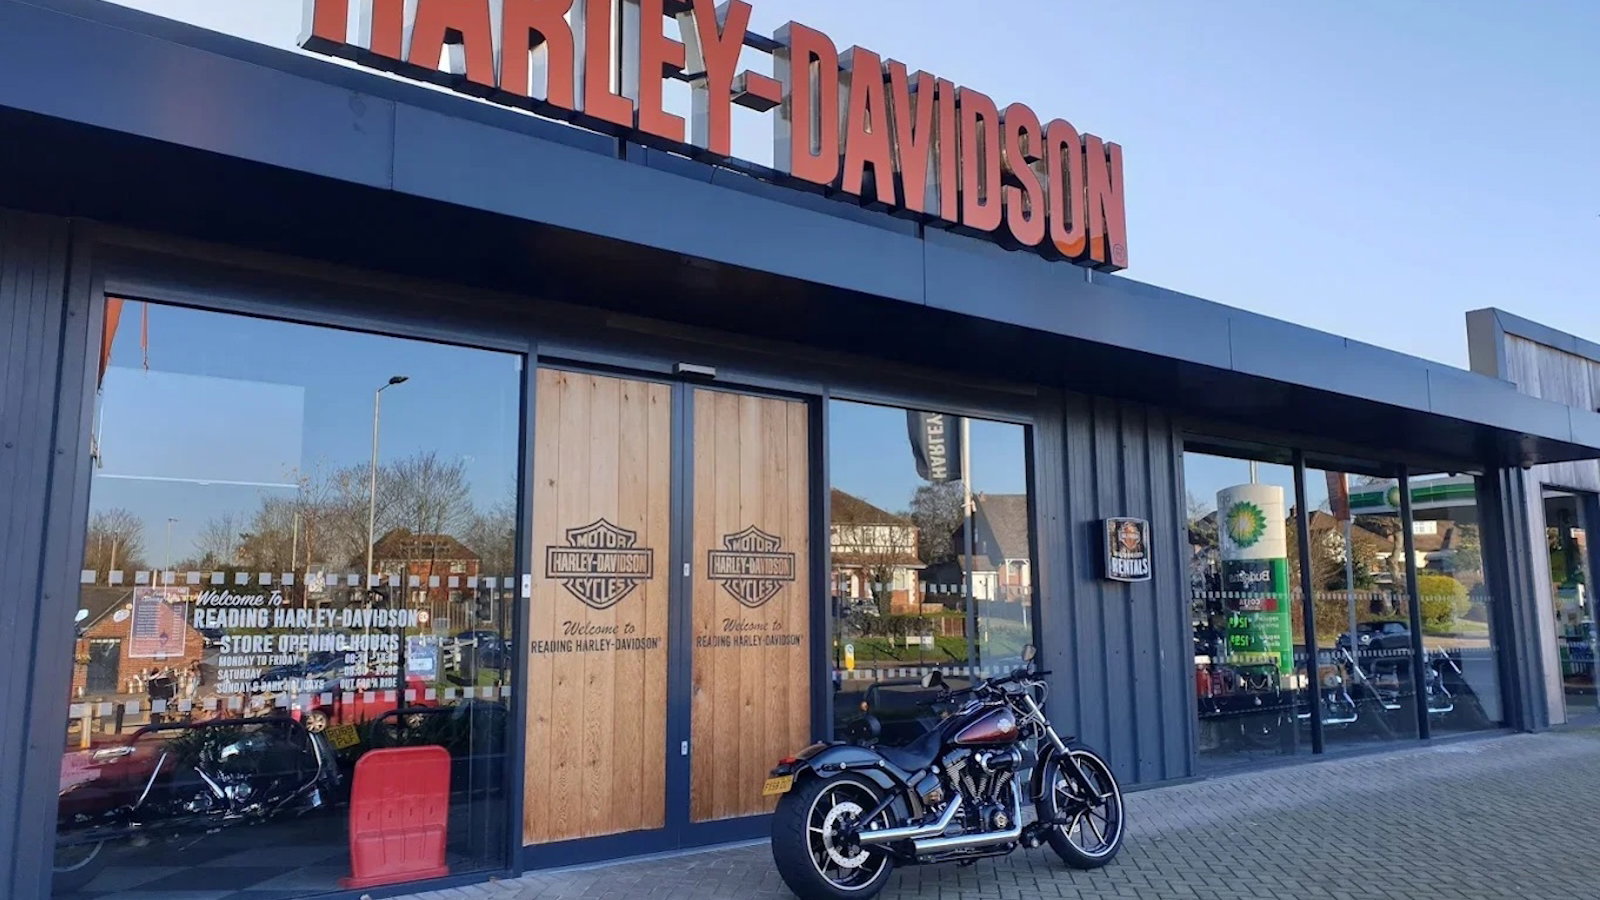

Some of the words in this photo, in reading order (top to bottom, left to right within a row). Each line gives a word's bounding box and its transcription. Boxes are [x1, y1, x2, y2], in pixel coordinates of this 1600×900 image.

[303, 0, 1128, 270] RLEY-DAVIDSON
[577, 533, 627, 548] MOTOR
[733, 538, 774, 552] MOTOR
[554, 551, 647, 574] HARLEY-DAVIDSON
[714, 556, 791, 576] HARLEY-DAVIDSON
[1111, 557, 1148, 575] RENTALS
[576, 578, 626, 599] CYCLES
[731, 579, 773, 598] CYCLES
[195, 589, 264, 606] Welcome
[268, 590, 283, 605] To
[193, 607, 269, 629] READING
[273, 607, 418, 629] HARLEY-DAVIDSON
[722, 618, 769, 632] Welcome
[772, 620, 783, 632] to
[563, 621, 618, 635] Welcome
[624, 622, 635, 634] to
[220, 634, 273, 654] STORE
[278, 633, 347, 653] OPENING
[351, 633, 399, 652] HOURS
[531, 639, 572, 653] READING
[575, 637, 658, 652] HARLEY-DAVIDSON
[696, 636, 731, 648] READING
[733, 635, 800, 648] HARLEY-DAVIDSON
[218, 656, 254, 667] MONDAY
[256, 655, 268, 666] TO
[269, 654, 299, 665] FRIDAY
[217, 668, 262, 680] SATURDAY
[216, 681, 250, 694] SUNDAY
[340, 678, 355, 690] OUT
[380, 677, 398, 688] RIDE
